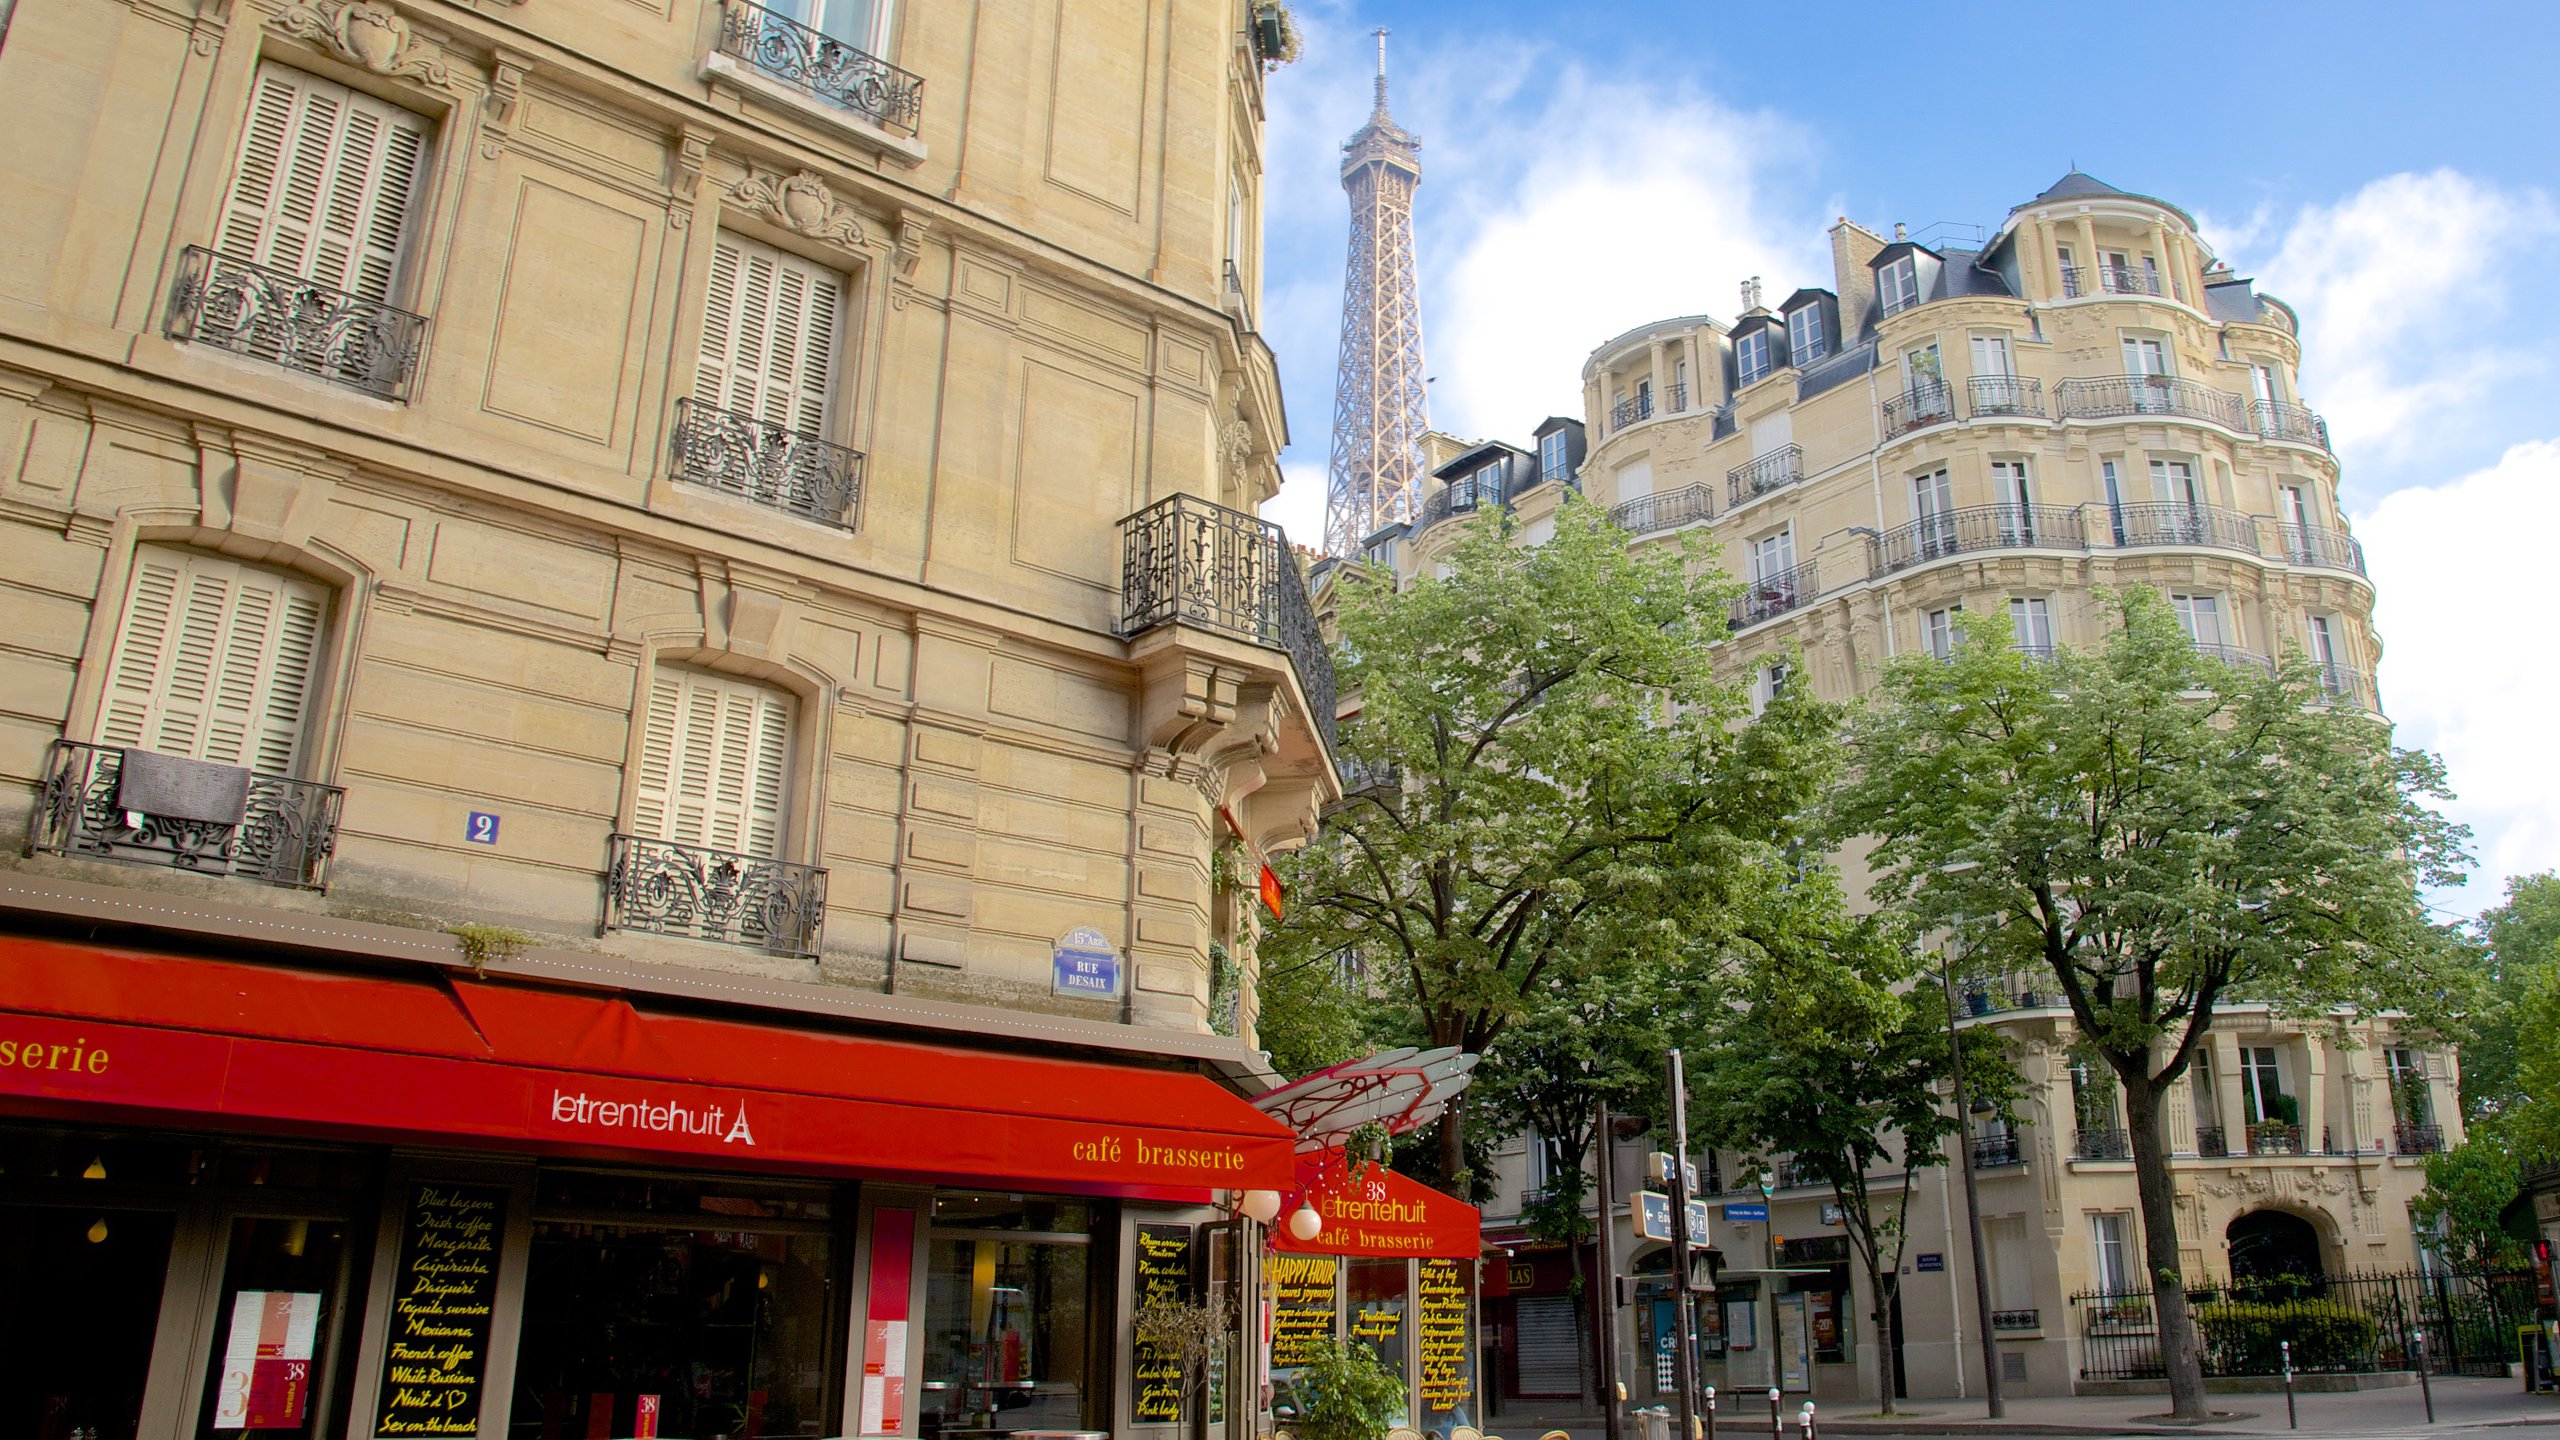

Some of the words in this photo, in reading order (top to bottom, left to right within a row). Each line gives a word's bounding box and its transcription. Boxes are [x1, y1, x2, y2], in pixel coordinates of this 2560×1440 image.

[474, 816, 492, 841] 2
[1077, 961, 1099, 974] RUE
[1069, 974, 1106, 989] DESAIX
[551, 1089, 724, 1136] letrentehuit
[1073, 1136, 1121, 1162] café
[1136, 1138, 1244, 1170] brasserie
[417, 1187, 447, 1208] Blue
[1366, 1181, 1386, 1201] 38
[1321, 1194, 1426, 1223] letrentehuit
[416, 1212, 452, 1228] Irish
[455, 1216, 492, 1237] coffee
[417, 1231, 493, 1257] Margarita
[1316, 1227, 1350, 1246] café
[1359, 1229, 1434, 1250] brasserie
[1271, 1257, 1309, 1284] HAPPY
[1307, 1259, 1336, 1285] HOUR
[1436, 1268, 1446, 1284] of
[397, 1298, 444, 1321] Tequila
[444, 1302, 489, 1315] sunrise
[1359, 1309, 1401, 1322] Traditional
[1435, 1313, 1464, 1324] Sandwich
[405, 1318, 474, 1336] Mexicana
[1352, 1323, 1380, 1337] French
[1379, 1323, 1397, 1342] food
[391, 1342, 436, 1359] French
[437, 1344, 474, 1370] coffee
[284, 1362, 305, 1381] 38
[391, 1366, 427, 1383] White
[427, 1368, 476, 1384] Russian
[390, 1387, 431, 1408] Nuit
[641, 1397, 655, 1413] 38
[1136, 1401, 1158, 1416] Pink
[378, 1413, 407, 1433] Sex
[406, 1423, 425, 1433] on
[425, 1416, 443, 1432] the
[443, 1416, 478, 1433] beach
